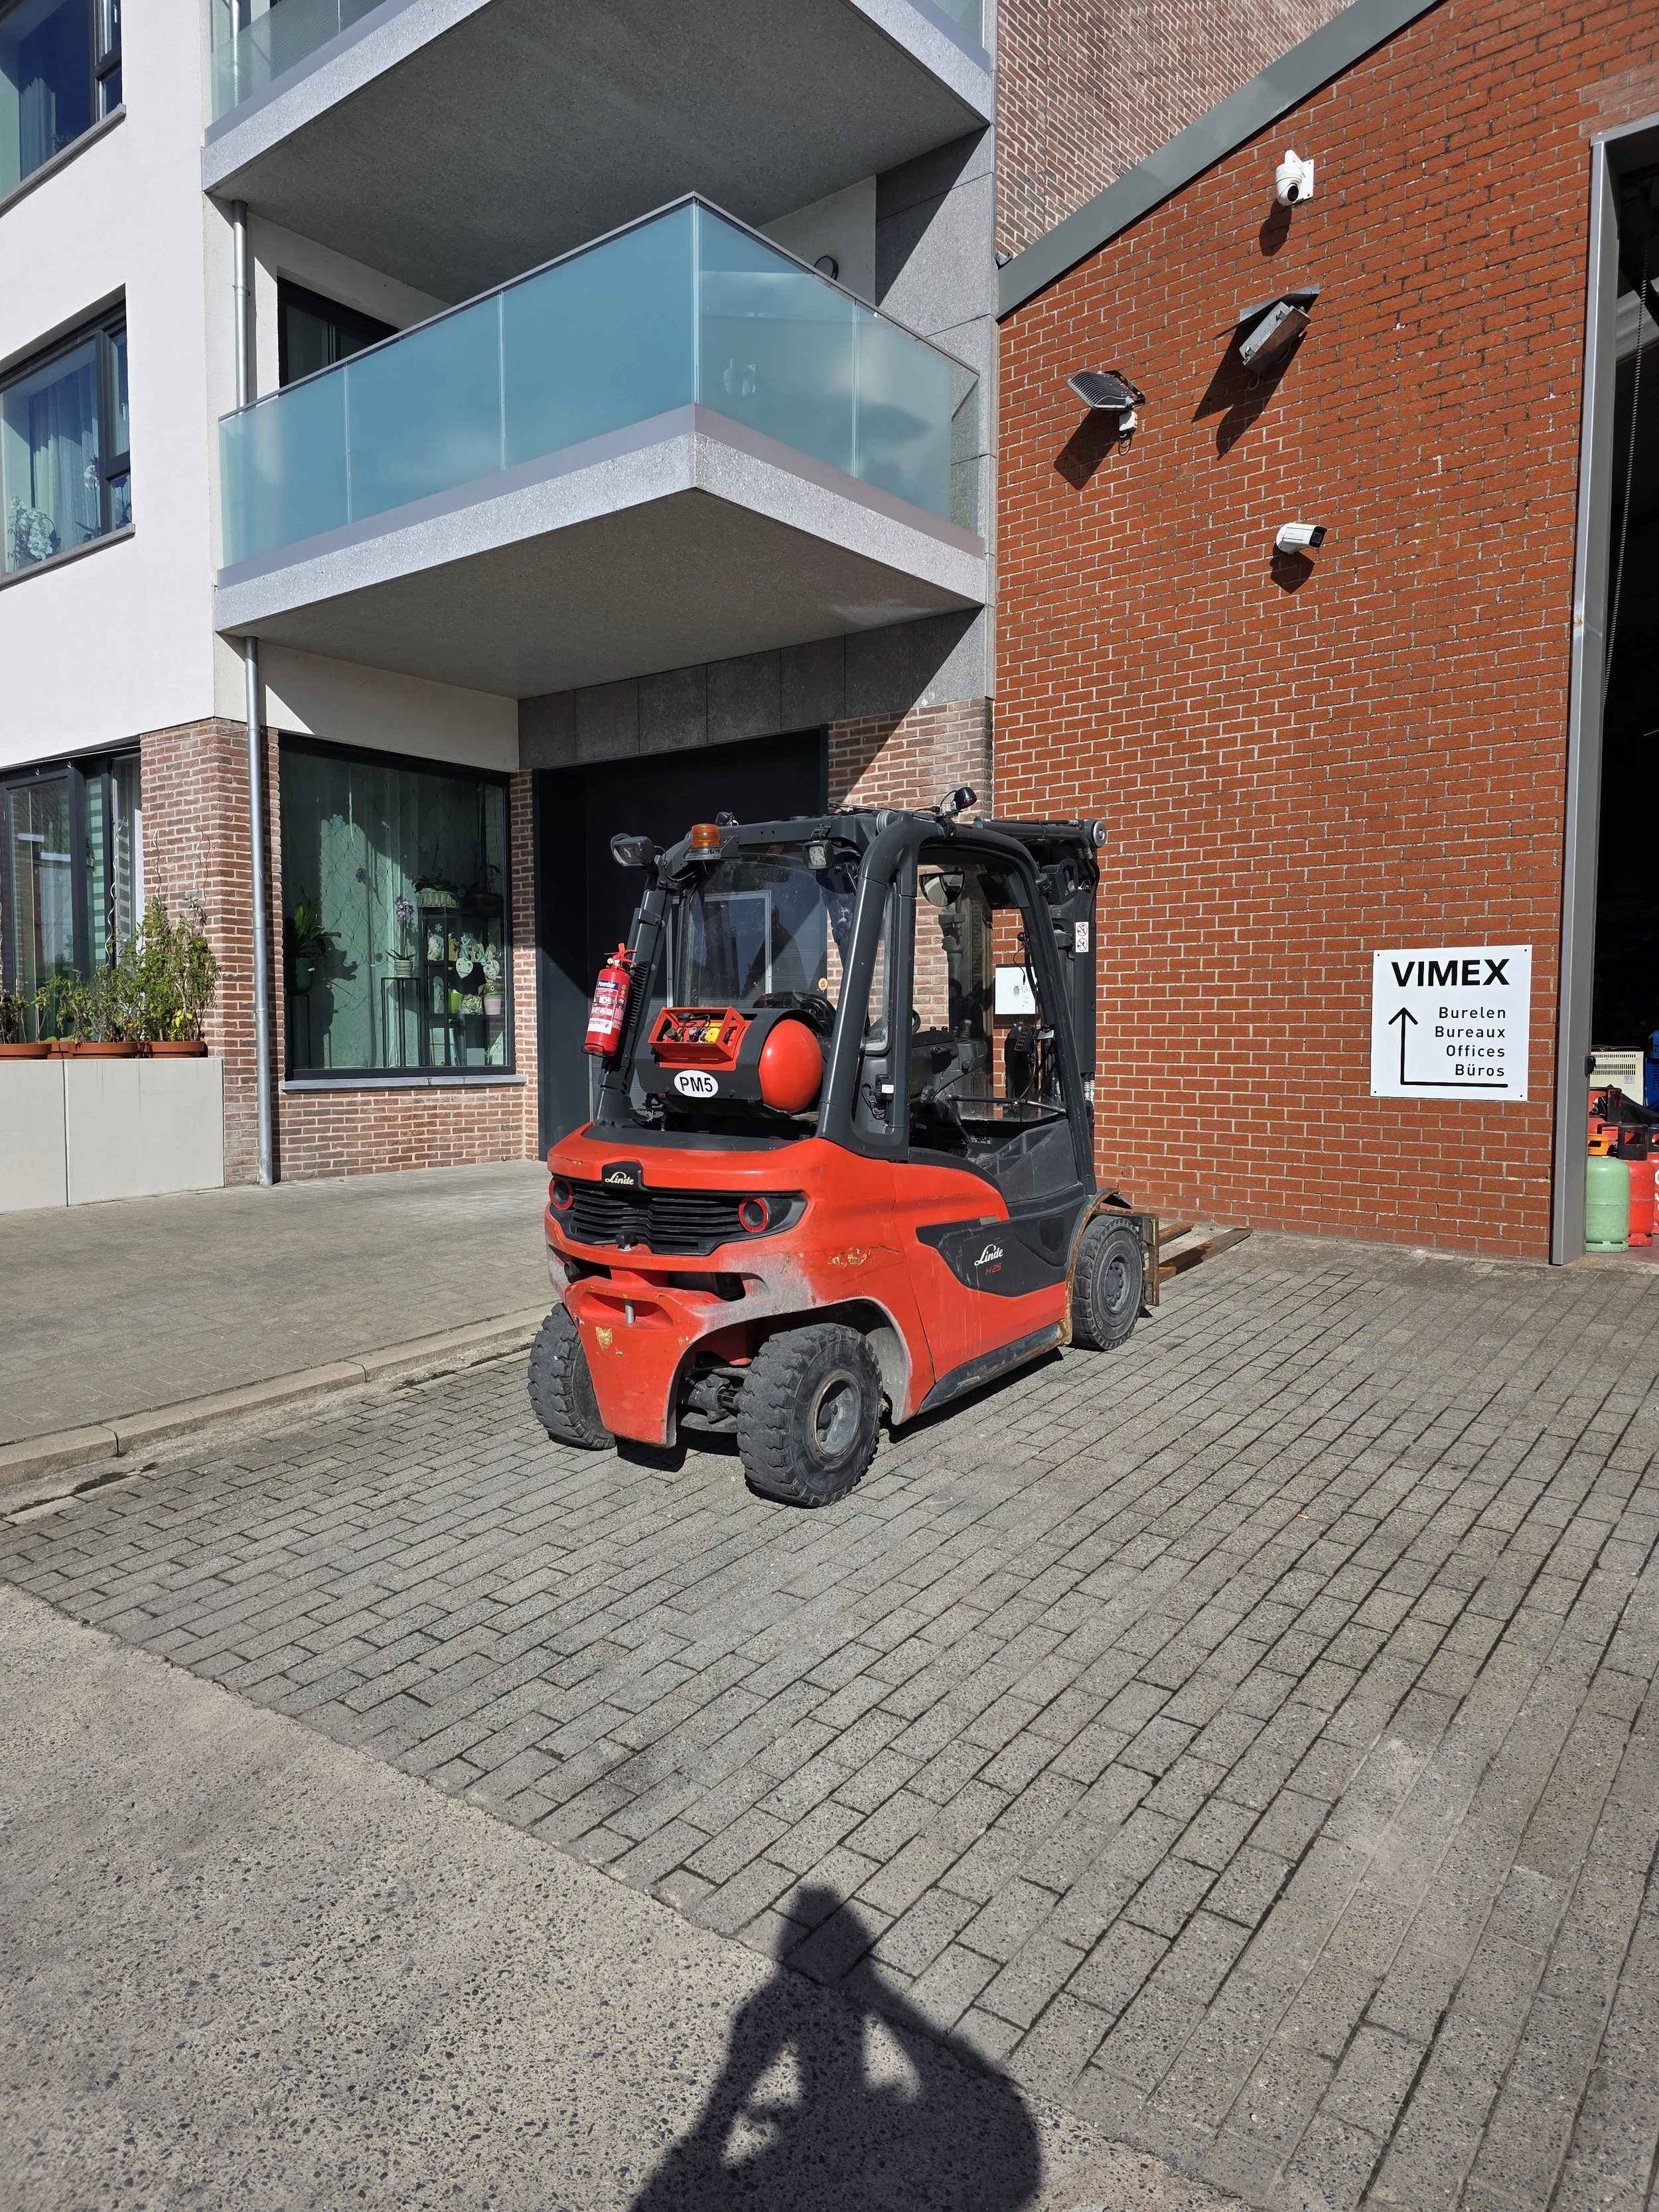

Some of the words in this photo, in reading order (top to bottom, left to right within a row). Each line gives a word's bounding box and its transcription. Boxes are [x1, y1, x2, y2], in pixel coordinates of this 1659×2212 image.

[1391, 958, 1510, 987] VIMEX
[1439, 1007, 1506, 1019] Burelen
[1435, 1026, 1506, 1037] Bureaux
[1447, 1045, 1505, 1057] Offices
[1455, 1064, 1504, 1076] Büros
[679, 1076, 713, 1093] PM5
[605, 1171, 634, 1185] Linde
[974, 1244, 1003, 1266] Linde
[985, 1262, 1002, 1275] H25
